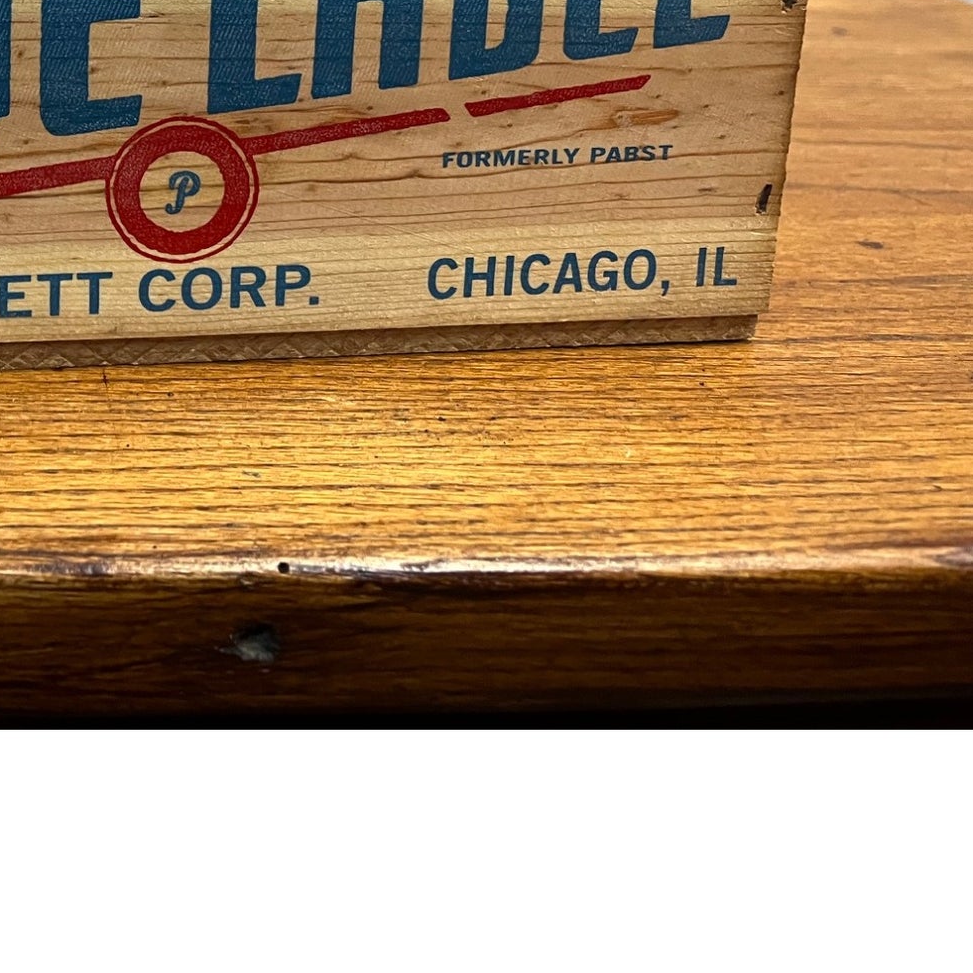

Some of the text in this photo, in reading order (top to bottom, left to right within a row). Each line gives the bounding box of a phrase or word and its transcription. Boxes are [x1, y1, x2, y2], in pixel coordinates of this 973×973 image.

[441, 143, 674, 170] FORMERLY PABST
[164, 170, 201, 215] P
[137, 264, 320, 313] CORP.
[427, 246, 738, 301] CHICAGO, IL
